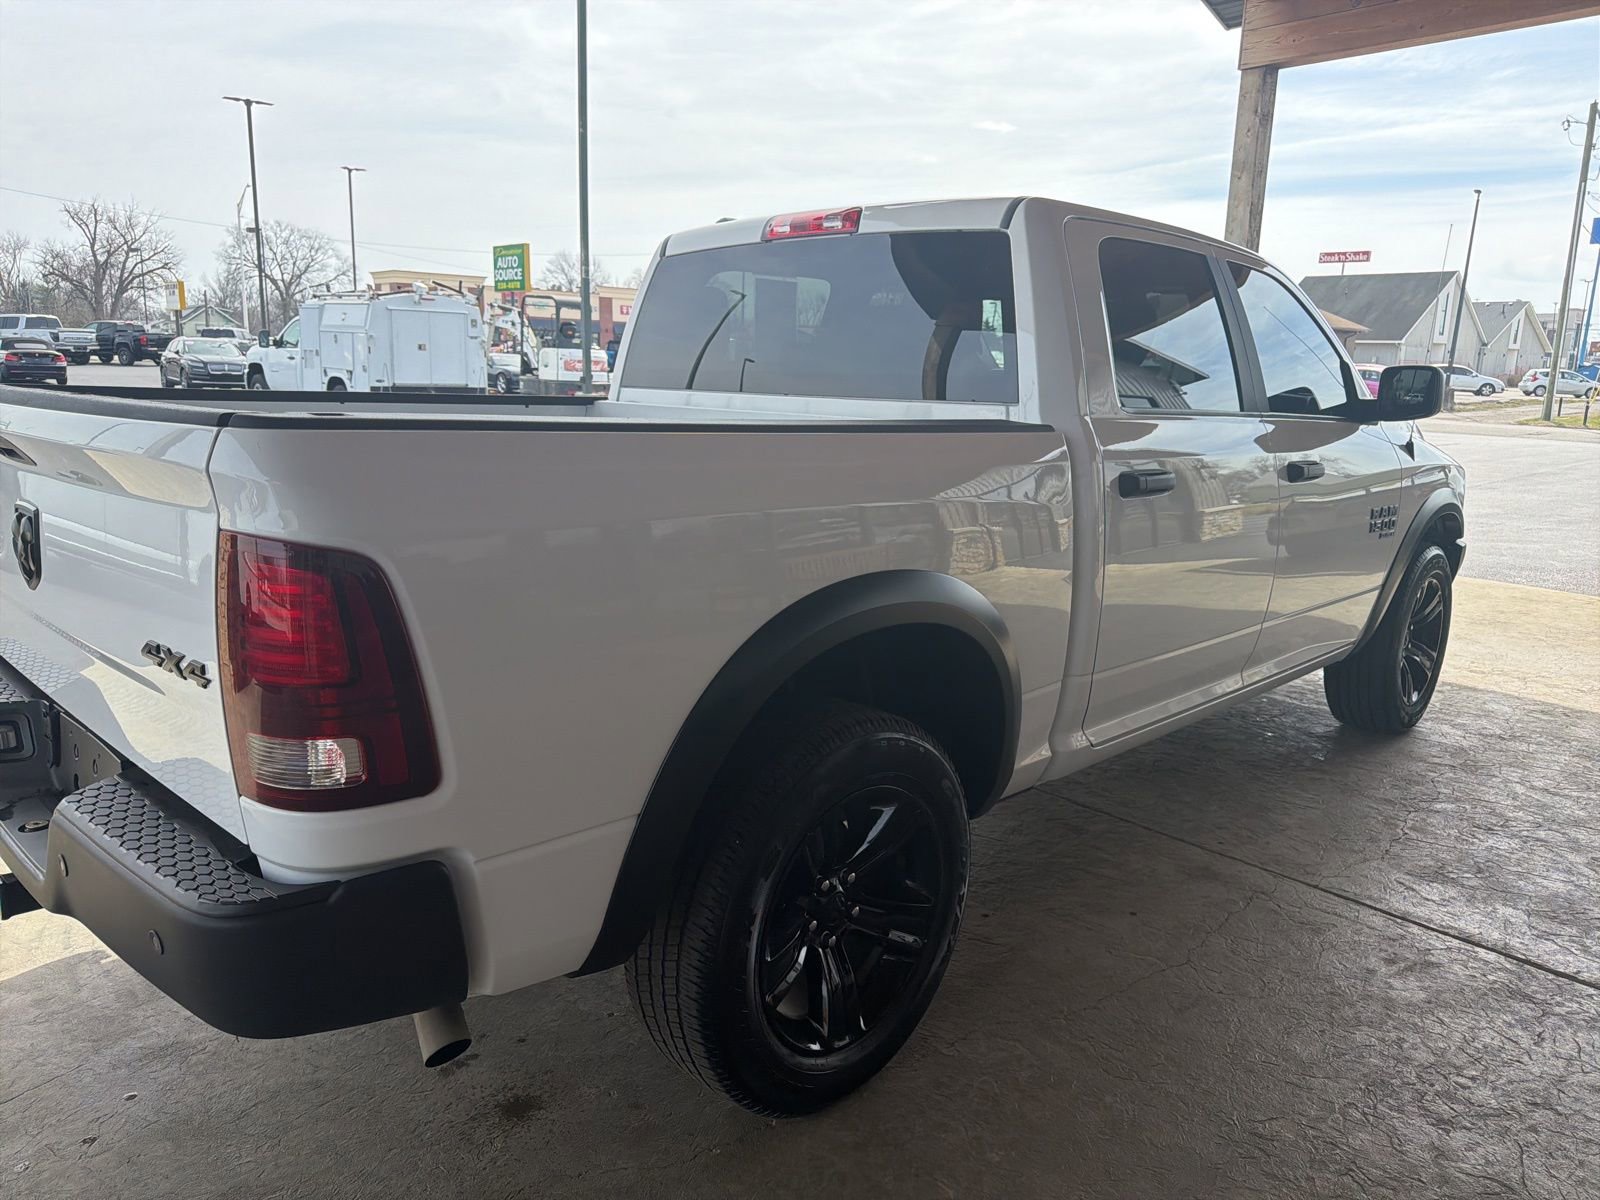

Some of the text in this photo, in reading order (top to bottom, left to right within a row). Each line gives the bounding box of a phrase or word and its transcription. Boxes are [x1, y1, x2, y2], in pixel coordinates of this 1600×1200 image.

[497, 256, 518, 268] AUTO
[1346, 252, 1368, 261] Shake
[495, 269, 522, 281] SOURCE
